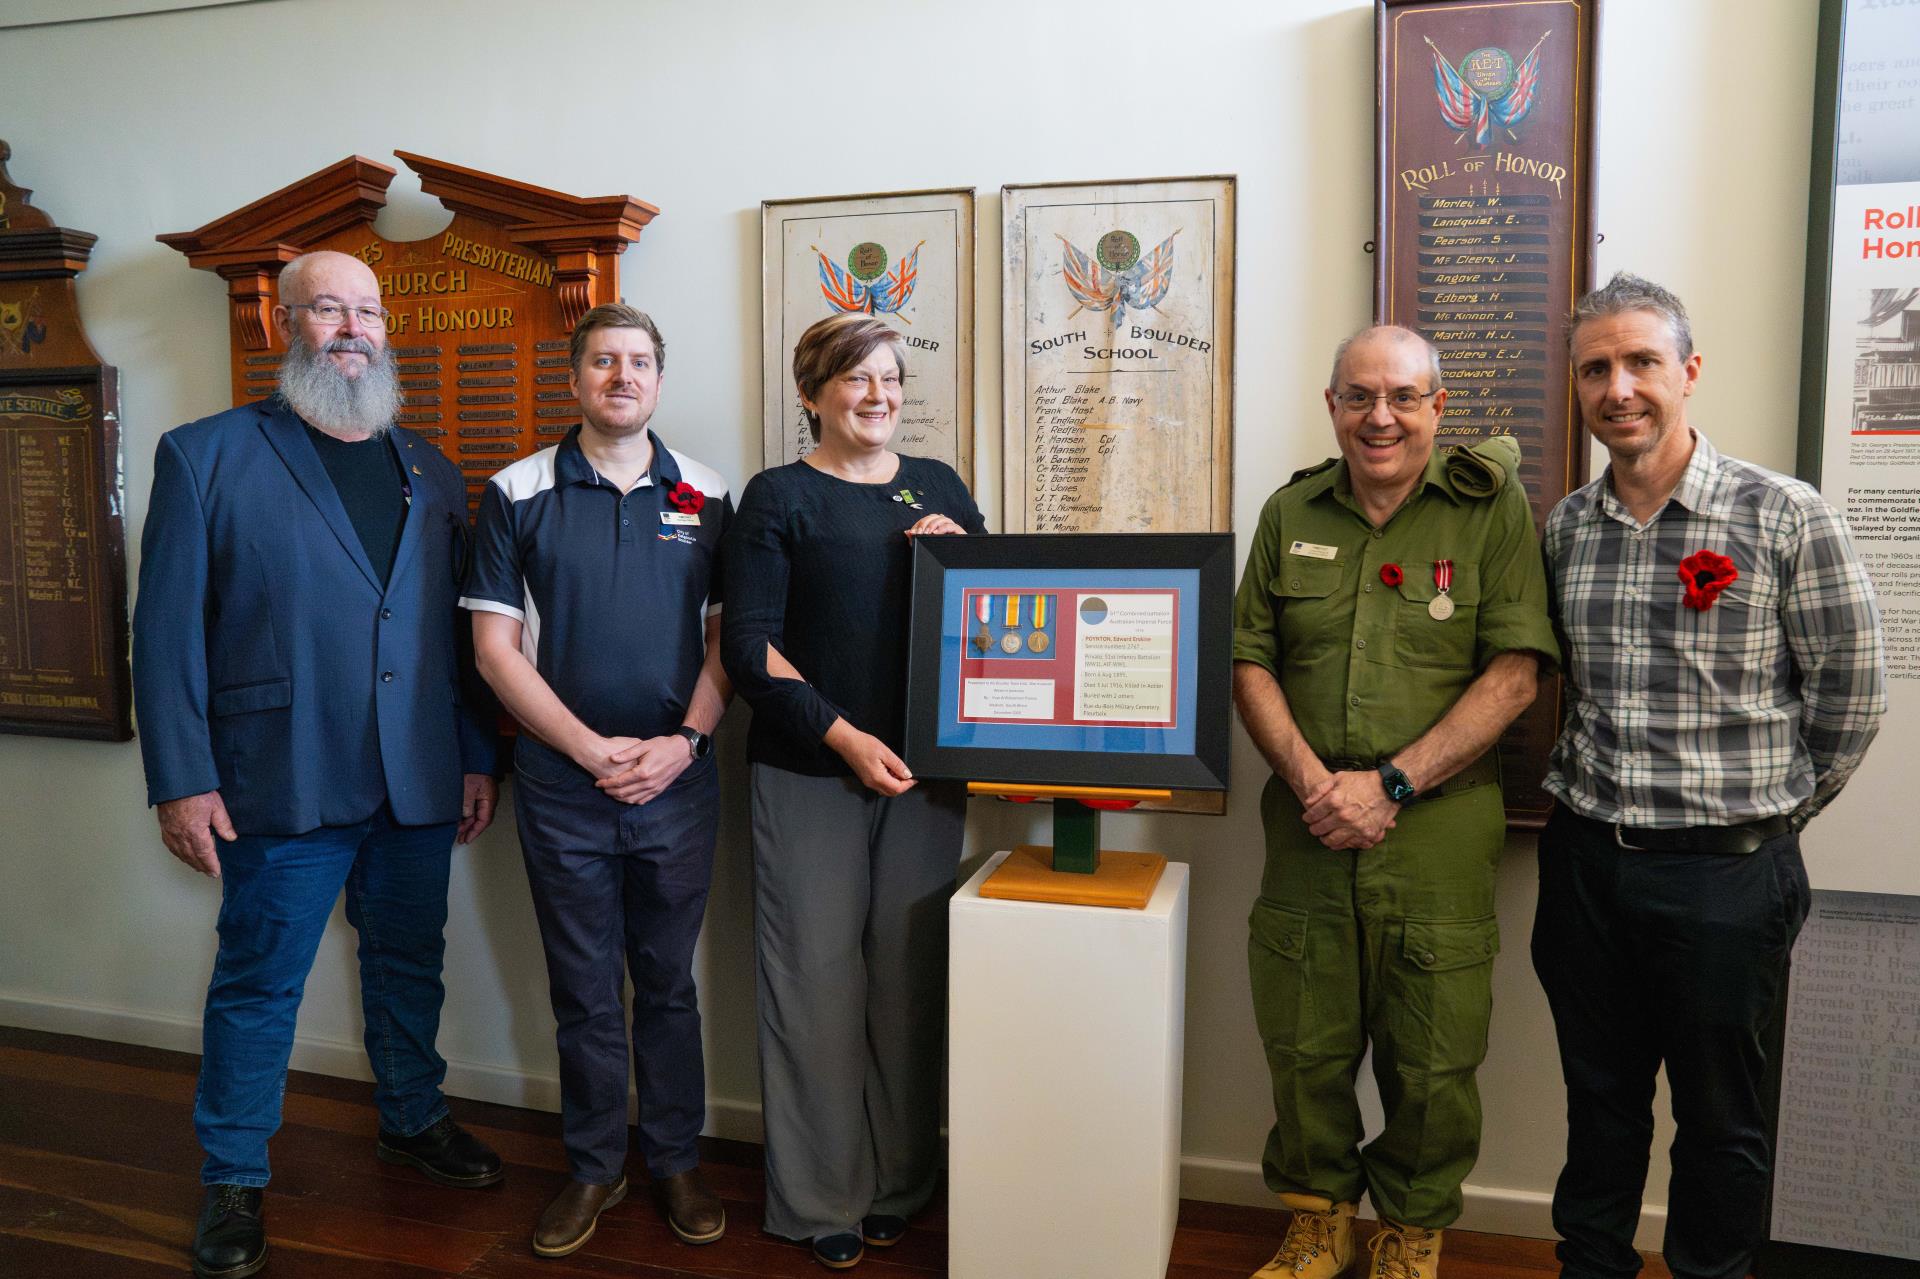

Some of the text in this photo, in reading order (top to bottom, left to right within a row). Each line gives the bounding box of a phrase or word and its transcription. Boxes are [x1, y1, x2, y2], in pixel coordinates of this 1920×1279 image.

[1400, 152, 1566, 200] ROLL OF HONOR
[1862, 237, 1920, 260] Hon
[442, 231, 555, 288] PRESBYTERIAN
[380, 269, 467, 296] HURCH
[385, 304, 514, 335] OF HONOUR
[903, 335, 939, 352] LDER
[1031, 326, 1211, 354] SOUTH BOULDER
[1084, 347, 1158, 359] SCHOOL
[1439, 369, 1501, 378] oodward.
[1035, 384, 1101, 394] Arthur Blake
[1035, 396, 1057, 405] Fred
[1062, 395, 1089, 405] Blake
[1441, 408, 1475, 418] yson.
[1051, 484, 1079, 492] Jones
